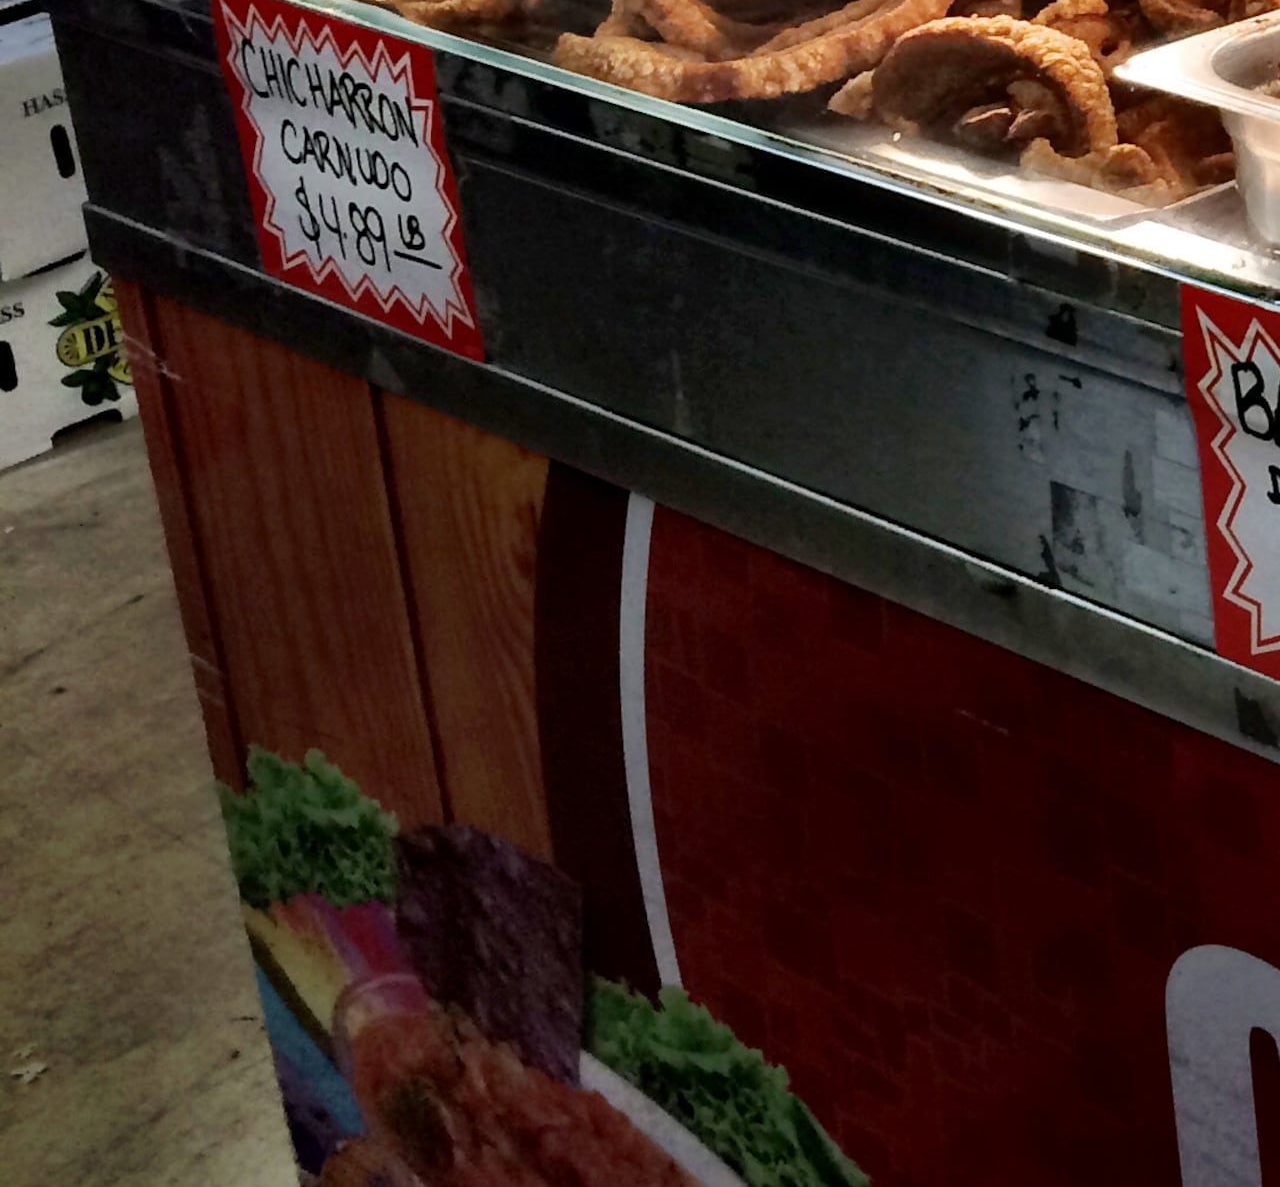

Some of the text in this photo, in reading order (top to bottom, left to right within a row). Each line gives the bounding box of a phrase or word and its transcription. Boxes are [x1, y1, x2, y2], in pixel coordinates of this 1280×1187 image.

[240, 38, 420, 149] CHICHARRON
[280, 118, 412, 203] CARNUDO
[295, 176, 433, 273] $4.89 LB
